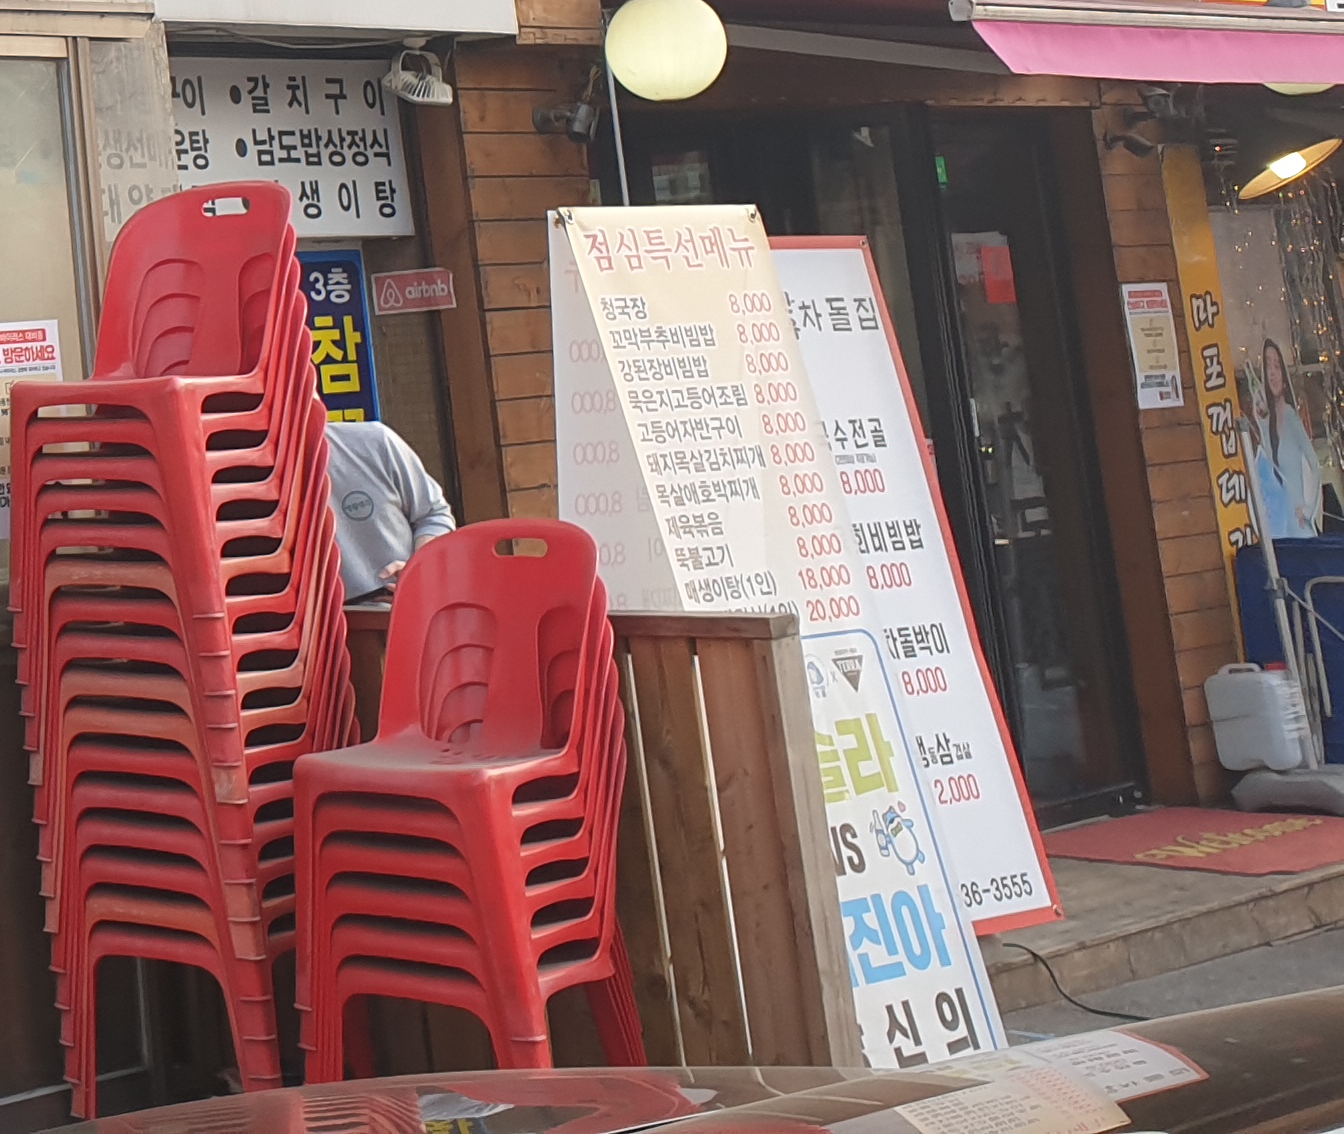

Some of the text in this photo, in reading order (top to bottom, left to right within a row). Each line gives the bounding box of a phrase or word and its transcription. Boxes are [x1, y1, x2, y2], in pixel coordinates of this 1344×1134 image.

[252, 127, 393, 168] 남도밥상정식
[583, 225, 757, 272] 점심특선메뉴
[309, 267, 352, 305] 3층
[405, 278, 449, 299] airbnb
[600, 291, 772, 322] 청국장 8,000
[798, 296, 881, 334] 차돌집
[2, 343, 57, 365] 방문하세요
[609, 322, 781, 353] 꼬막부추비빔밥 8,000
[618, 351, 789, 383] 강된장비빔밥 8,000
[628, 381, 798, 414] 묵은지고등어조림 8,000
[637, 411, 807, 444] 고등어자반구이 8,000
[646, 444, 767, 477] 돼지목살김치찌개
[771, 441, 816, 466] 8,000
[656, 472, 824, 509] 목살애호박찌개 8,000
[839, 468, 887, 496] 8,000
[665, 502, 833, 541] 제육볶음 8,000
[674, 533, 842, 571] 뚝불고기 8,000
[798, 564, 852, 590] 18,000
[866, 561, 913, 591] 8,000
[806, 595, 859, 623] 20,000
[841, 883, 953, 988] 진아
